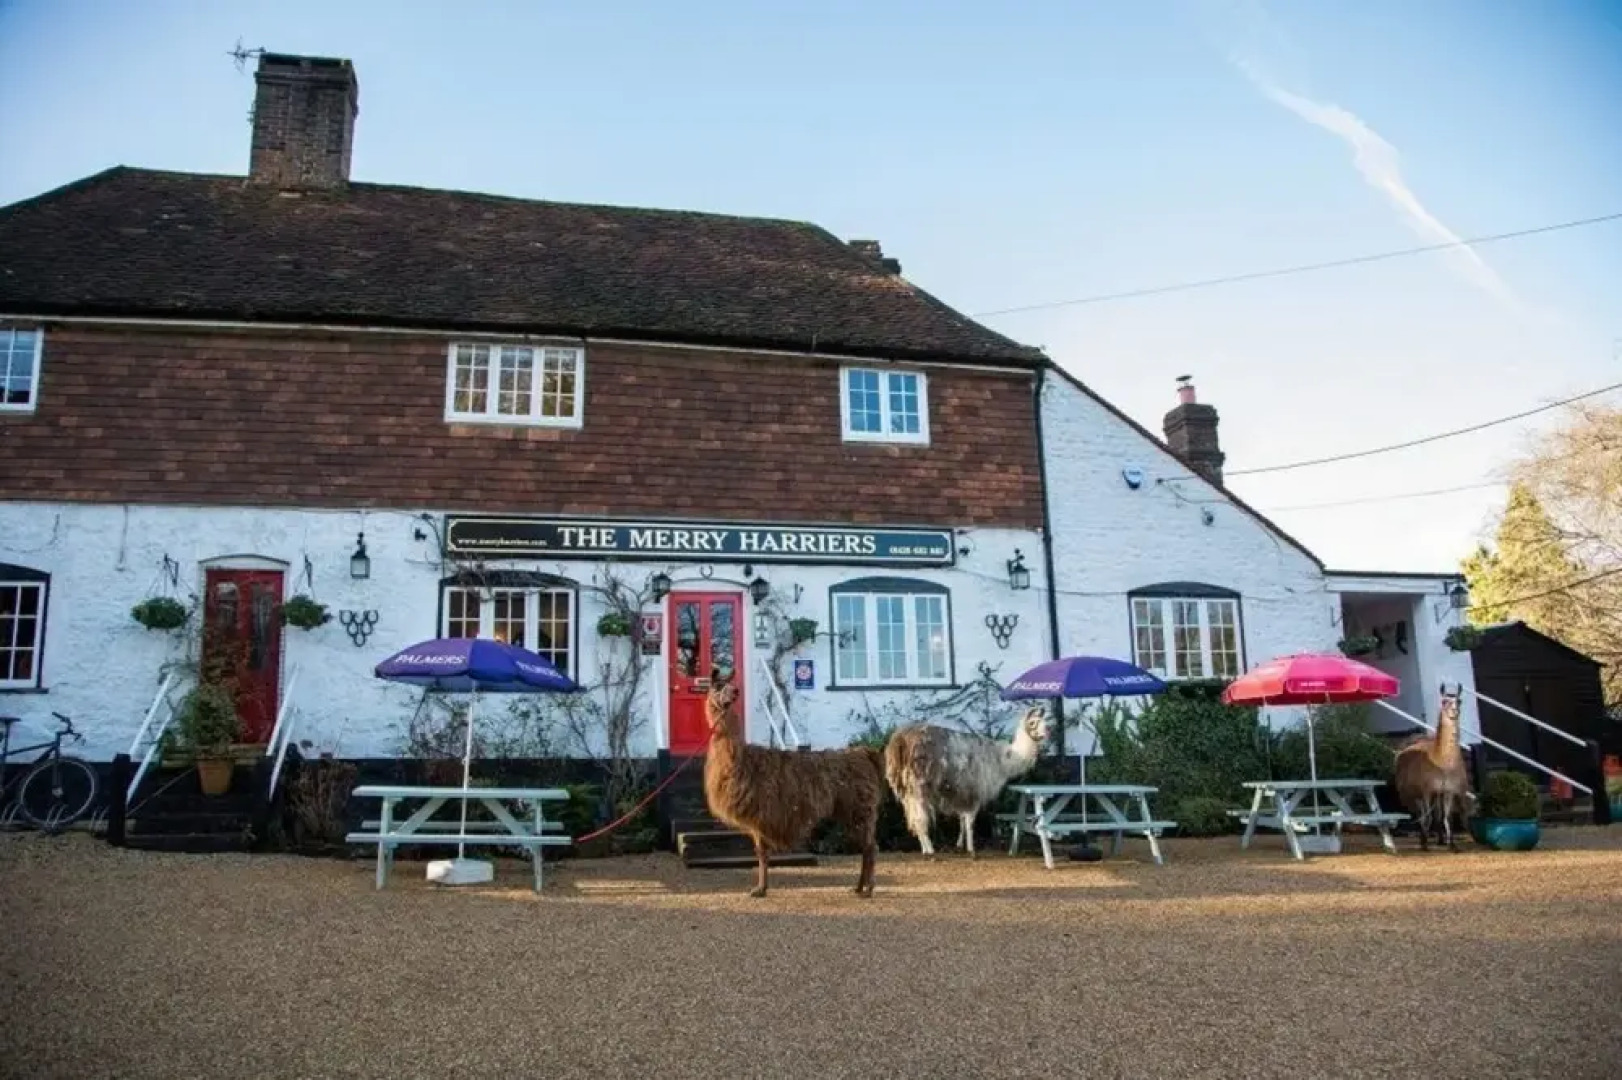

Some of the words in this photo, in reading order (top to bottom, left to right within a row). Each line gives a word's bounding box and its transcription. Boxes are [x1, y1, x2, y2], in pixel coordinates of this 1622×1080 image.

[558, 526, 617, 547] THE
[628, 528, 729, 550] MERRY
[739, 531, 876, 554] HARRIERS
[395, 654, 466, 664] PALMERS
[1012, 681, 1063, 692] PALMERS
